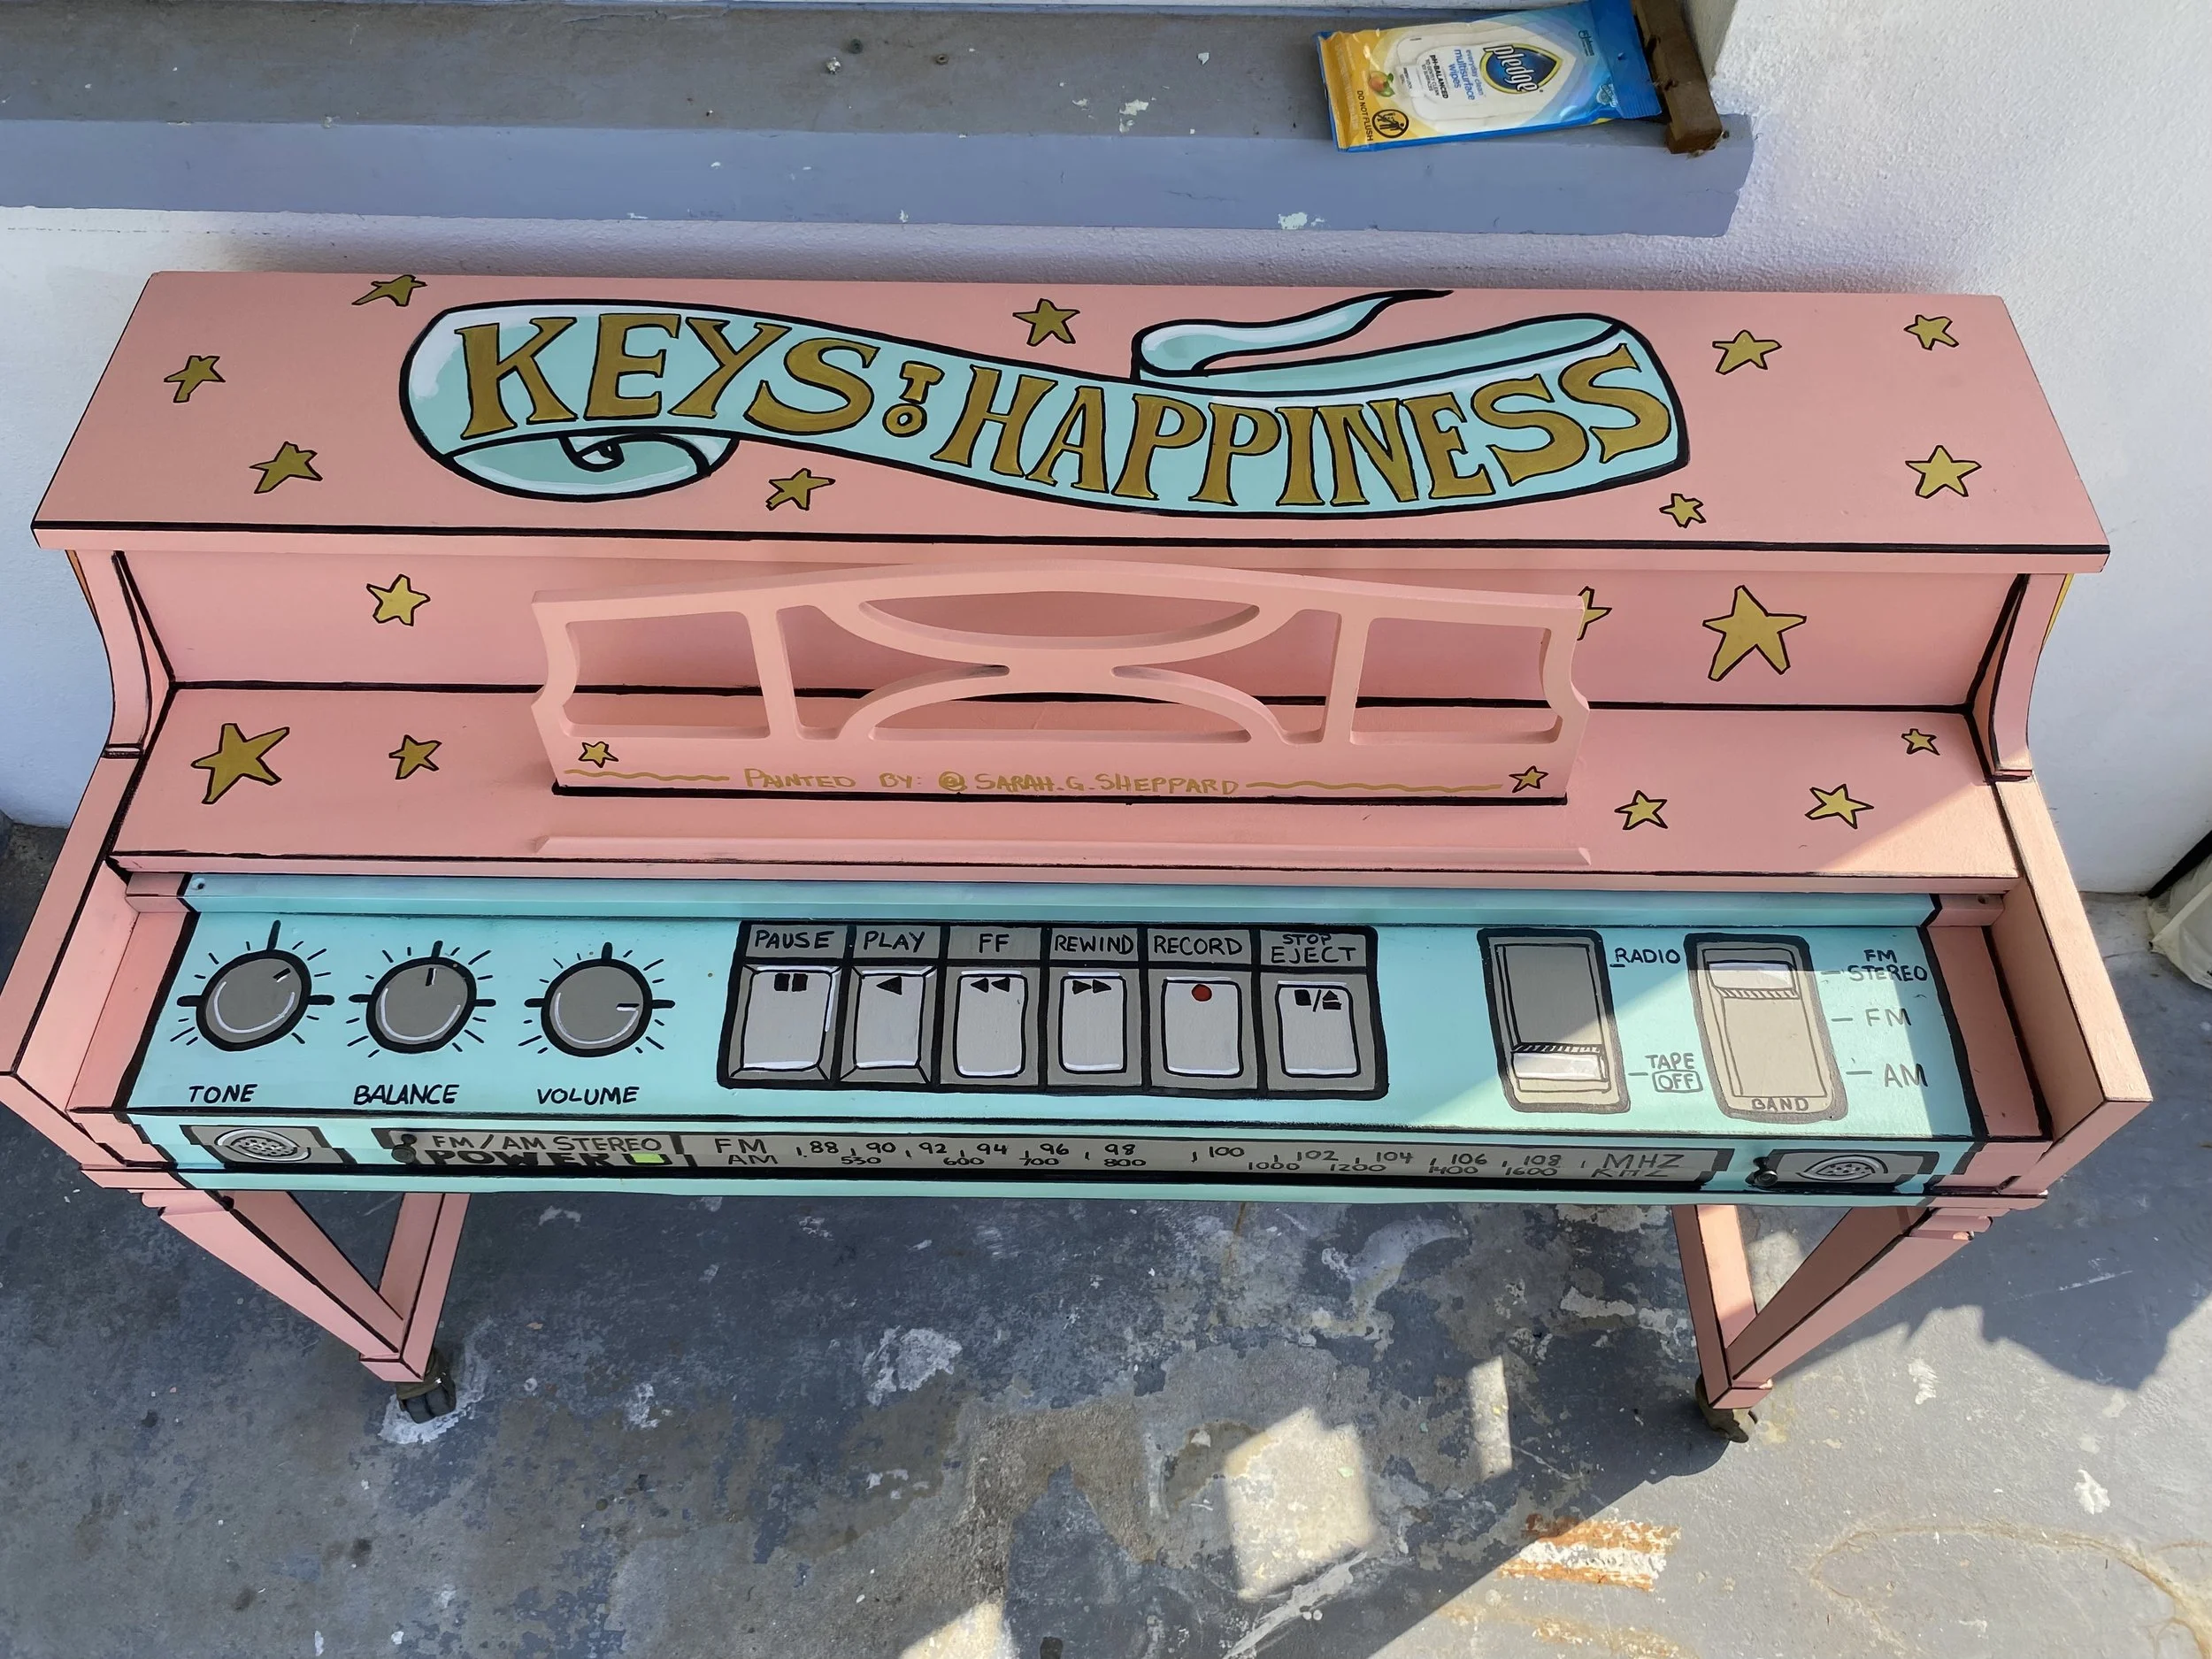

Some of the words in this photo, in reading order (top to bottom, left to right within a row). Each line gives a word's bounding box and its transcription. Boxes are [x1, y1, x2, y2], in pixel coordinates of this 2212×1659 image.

[1466, 49, 1479, 78] everyday
[1483, 44, 1540, 93] pledge
[1429, 54, 1449, 99] pH-BALANCED
[1448, 63, 1462, 88] wipes
[1454, 49, 1476, 101] multisurface
[1356, 90, 1365, 101] DO
[1360, 101, 1369, 117] NOT
[1363, 115, 1374, 142] FLUSH
[454, 312, 882, 440] KEYS
[931, 343, 1671, 507] HAPPINESS
[744, 767, 856, 788] PAINTED
[879, 772, 922, 788] BY:
[754, 930, 835, 949] PAUSE
[863, 931, 926, 953] PLAY
[979, 933, 1010, 954] FF
[1054, 934, 1134, 955] REWIND
[1153, 936, 1243, 956] RECORD
[1281, 933, 1333, 946] STOP
[1271, 946, 1357, 964] EJECT
[1614, 948, 1681, 965] RADIO
[1863, 949, 1899, 964] FM
[1847, 964, 1928, 982] STEREO
[1865, 1008, 1912, 1027] FM
[1645, 1053, 1694, 1071] TAPE
[1658, 1074, 1696, 1090] OFF
[1884, 1063, 1929, 1088] AM
[188, 1083, 258, 1104] TONE
[353, 1084, 460, 1106] BALANCE
[537, 1086, 640, 1106] VOLUME
[1751, 1096, 1810, 1113] BAND
[552, 1135, 663, 1152] STEREO
[714, 1138, 768, 1155] FM
[810, 1141, 840, 1155] 88
[866, 1141, 896, 1154] 90
[918, 1141, 948, 1154] 92
[977, 1143, 1009, 1156] 94
[1040, 1142, 1070, 1156] 96
[1104, 1143, 1136, 1156] 98
[1209, 1146, 1245, 1158] 100
[1296, 1150, 1340, 1162] 102
[1376, 1151, 1414, 1164] 104
[1451, 1153, 1488, 1166] 106
[1523, 1154, 1562, 1166] 108
[1602, 1153, 1685, 1169] MHZ
[424, 1150, 618, 1166] POWER
[728, 1154, 779, 1165] AM
[841, 1156, 882, 1165] 530
[943, 1156, 985, 1166] 600
[1019, 1156, 1060, 1167] 700
[1104, 1158, 1147, 1167] 800
[1248, 1161, 1301, 1171] 1000
[1330, 1163, 1386, 1172] 1200
[1428, 1165, 1479, 1175] 1400
[1505, 1166, 1559, 1177] 1600
